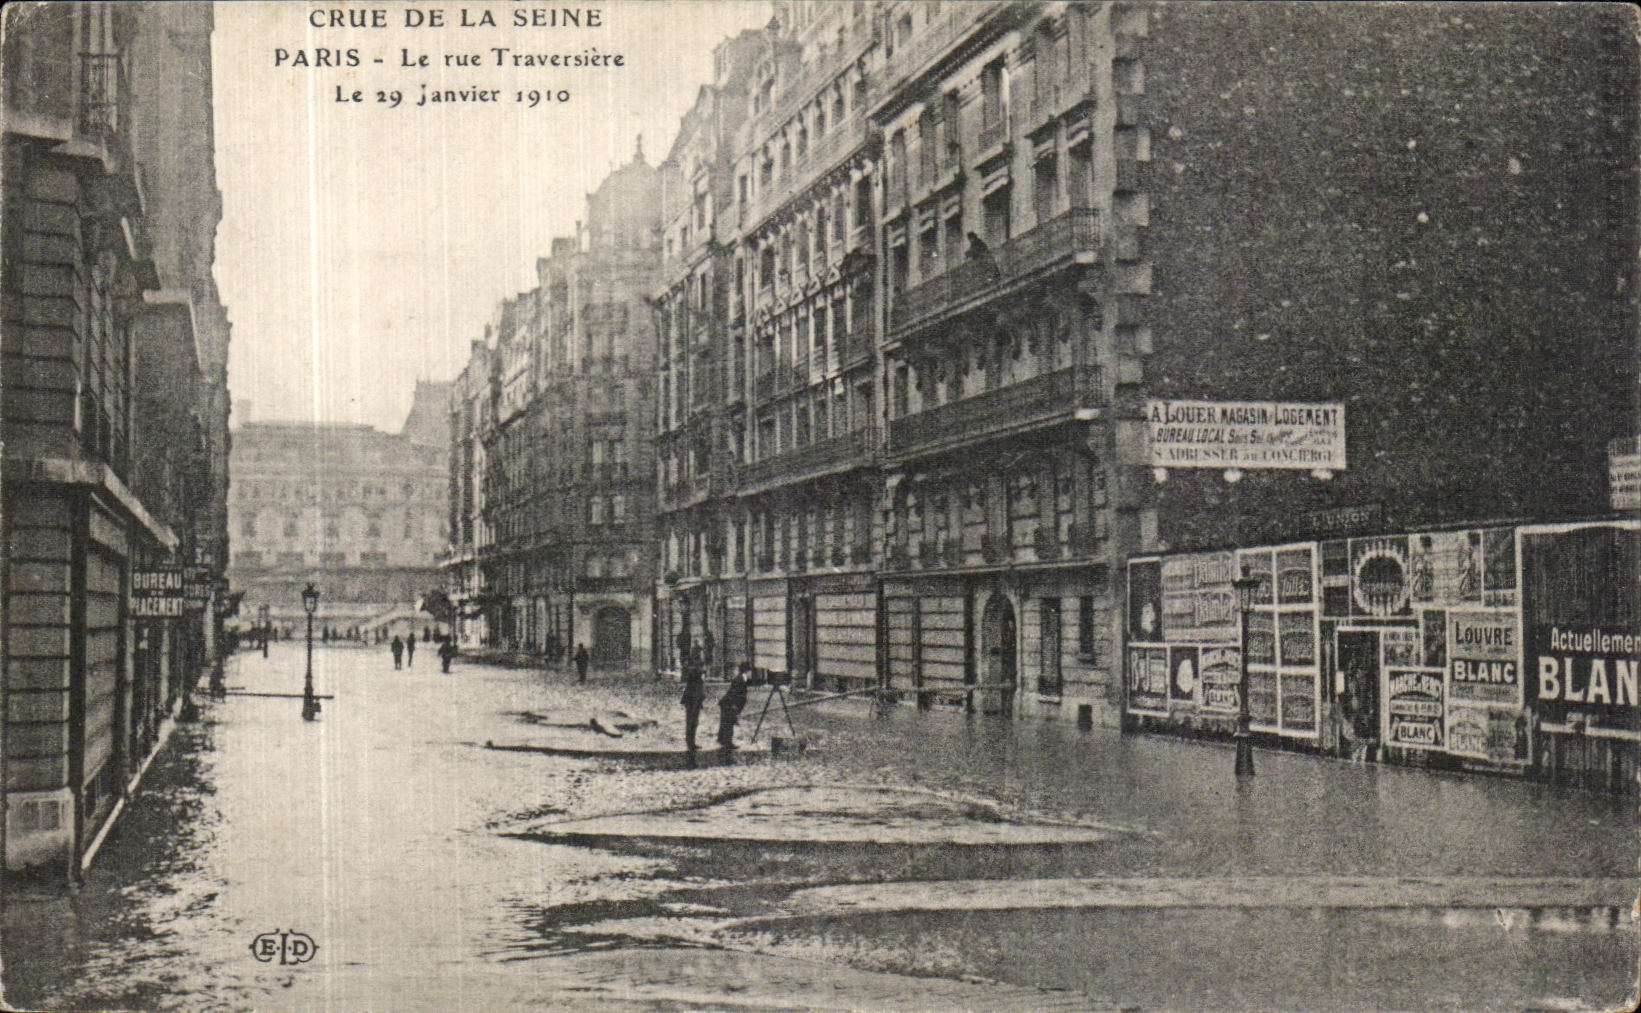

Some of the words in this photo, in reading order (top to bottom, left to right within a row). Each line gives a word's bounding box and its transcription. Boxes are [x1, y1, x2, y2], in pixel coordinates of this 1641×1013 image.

[1165, 402, 1217, 425] LOUER
[1220, 406, 1268, 425] MAGASIN
[1274, 404, 1338, 426] LOGEMENT
[1156, 427, 1194, 443] BUREAU
[1196, 428, 1225, 444] LOCAL
[133, 572, 182, 589] BUREAU
[128, 597, 184, 617] PLACEMENT
[1455, 621, 1513, 646] LOUVRE
[1454, 660, 1515, 684] BLANC
[1538, 655, 1640, 707] BLAN
[1400, 725, 1433, 741] BLANC
